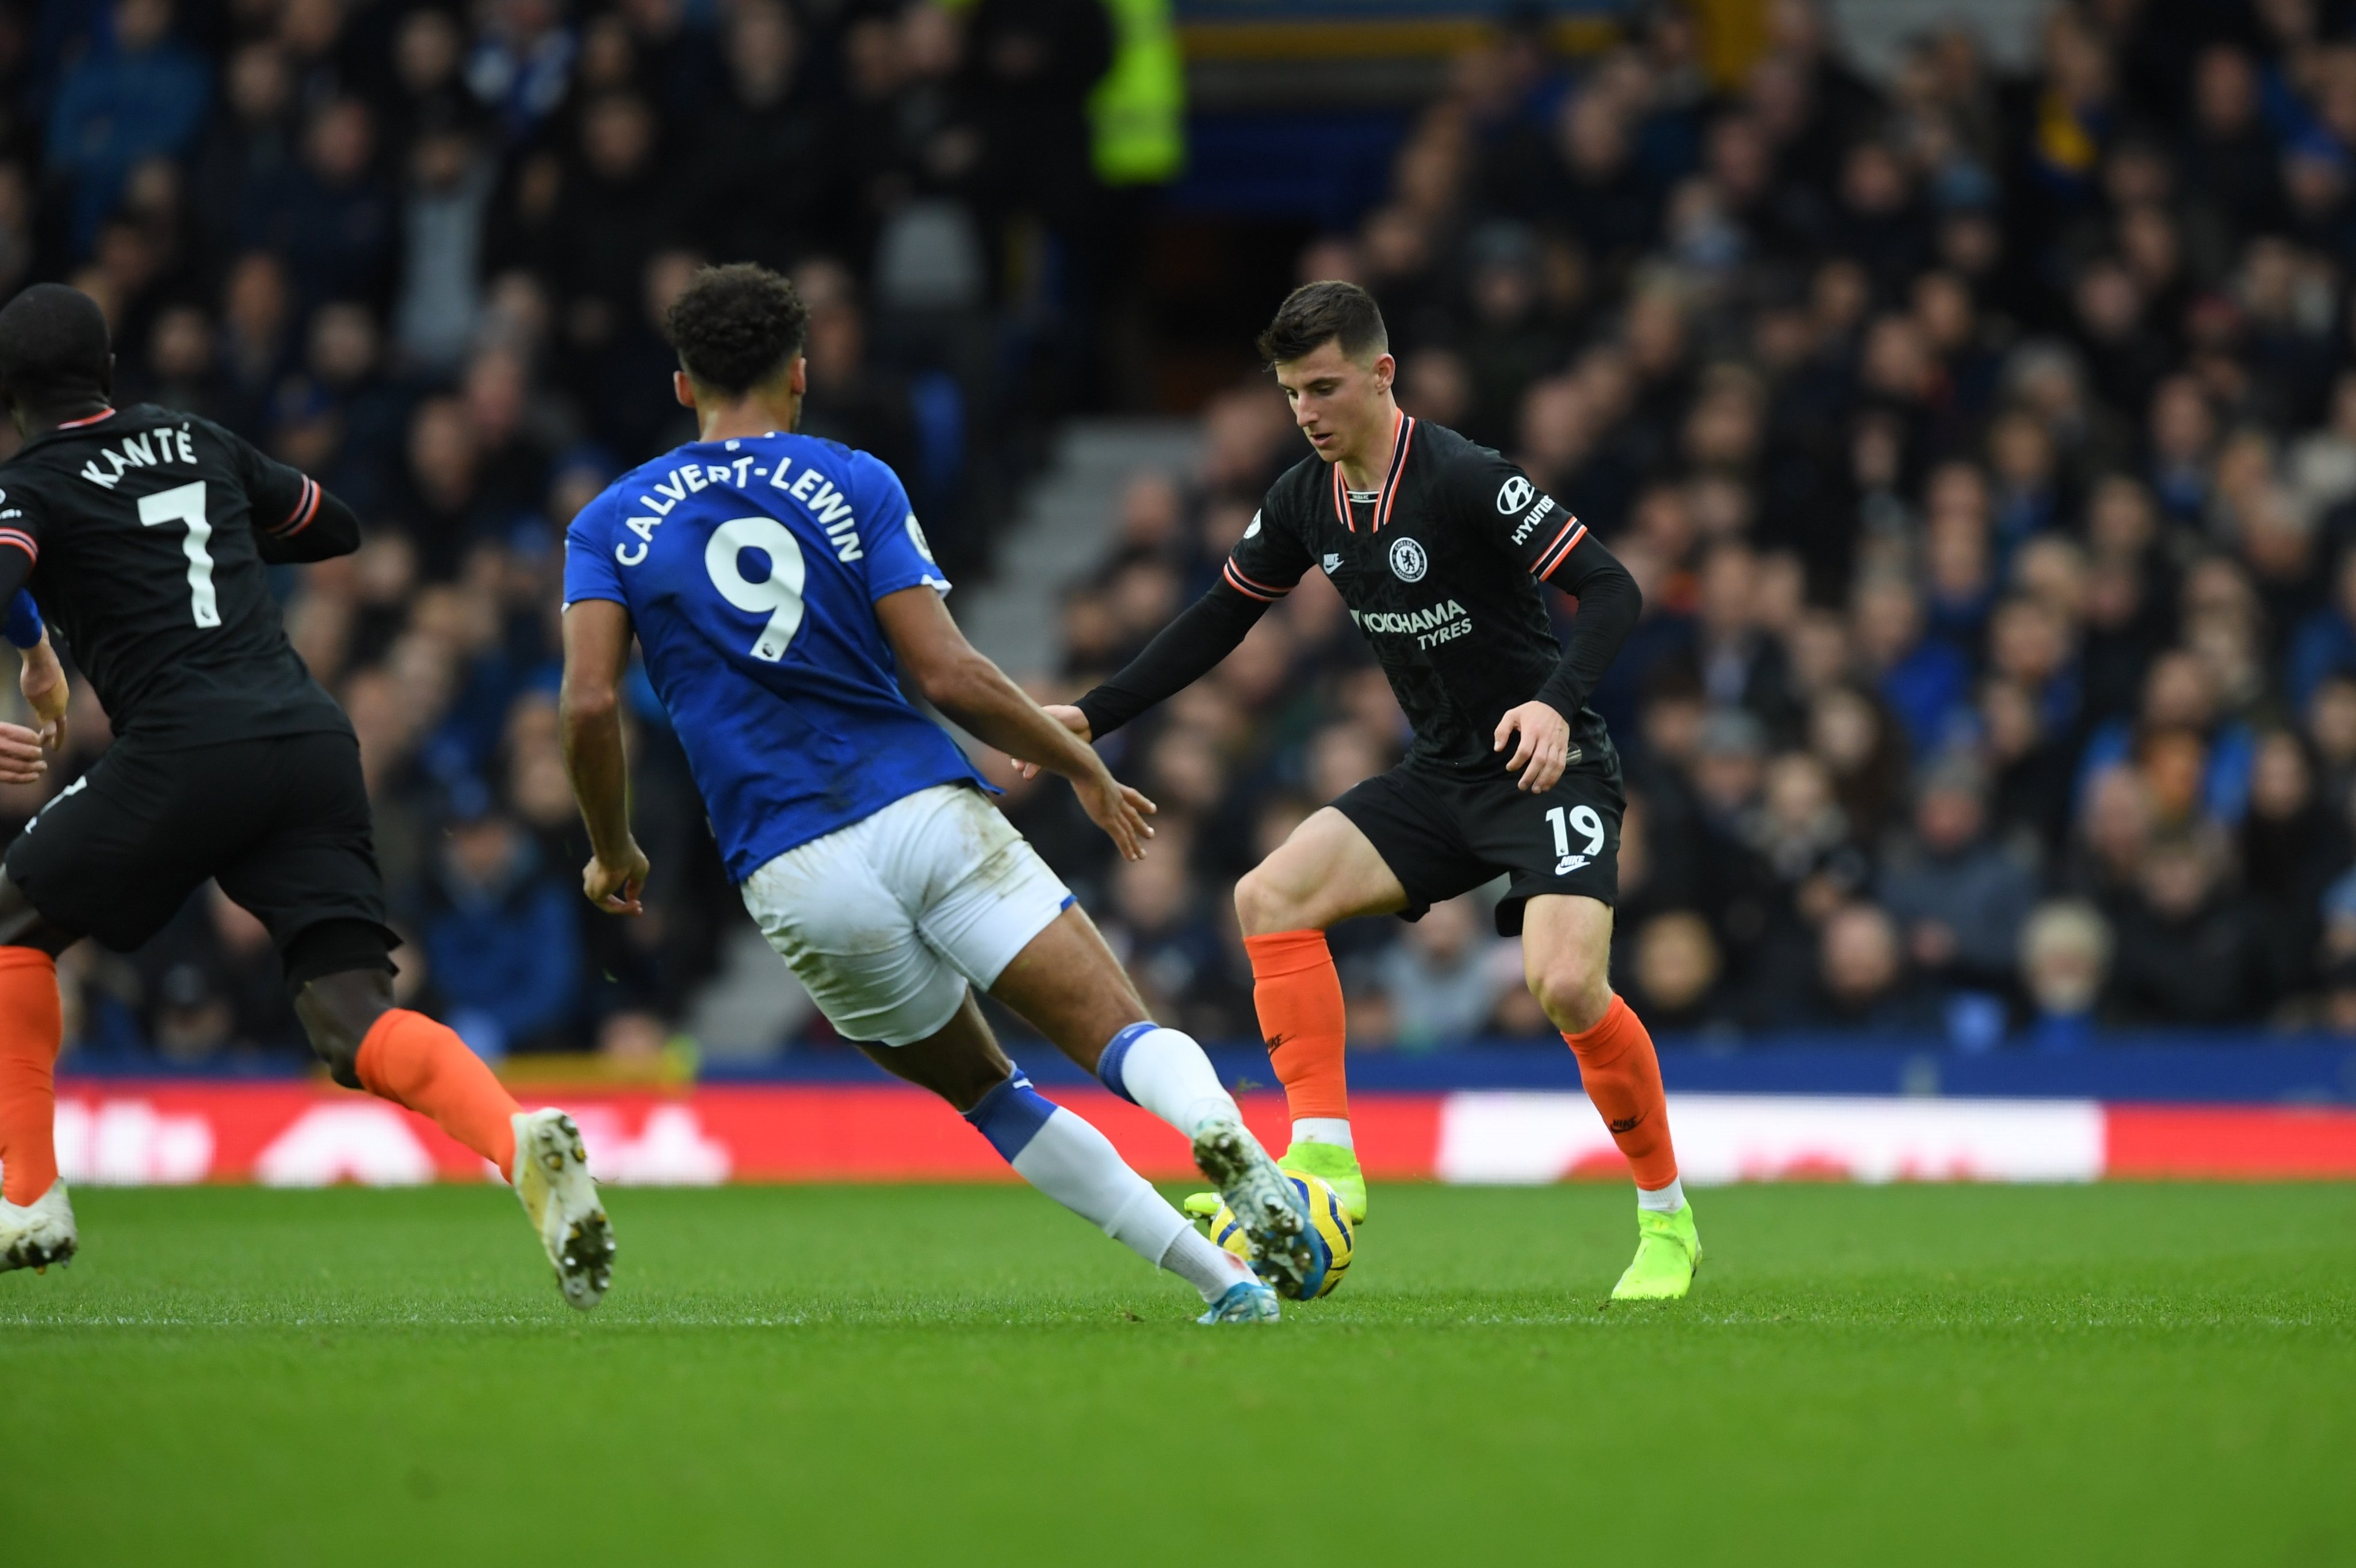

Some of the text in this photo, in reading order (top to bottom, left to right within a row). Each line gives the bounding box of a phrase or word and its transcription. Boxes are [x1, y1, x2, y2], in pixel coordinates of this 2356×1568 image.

[81, 422, 198, 489] KANTÉ
[615, 456, 863, 567] CALVERT-LEWIN
[137, 480, 222, 629] 7
[704, 517, 806, 662] 9
[1361, 599, 1467, 634] YOKOHAMA
[1417, 618, 1472, 651] TYRES
[1545, 805, 1605, 857] 19
[1560, 855, 1585, 867] NIKE
